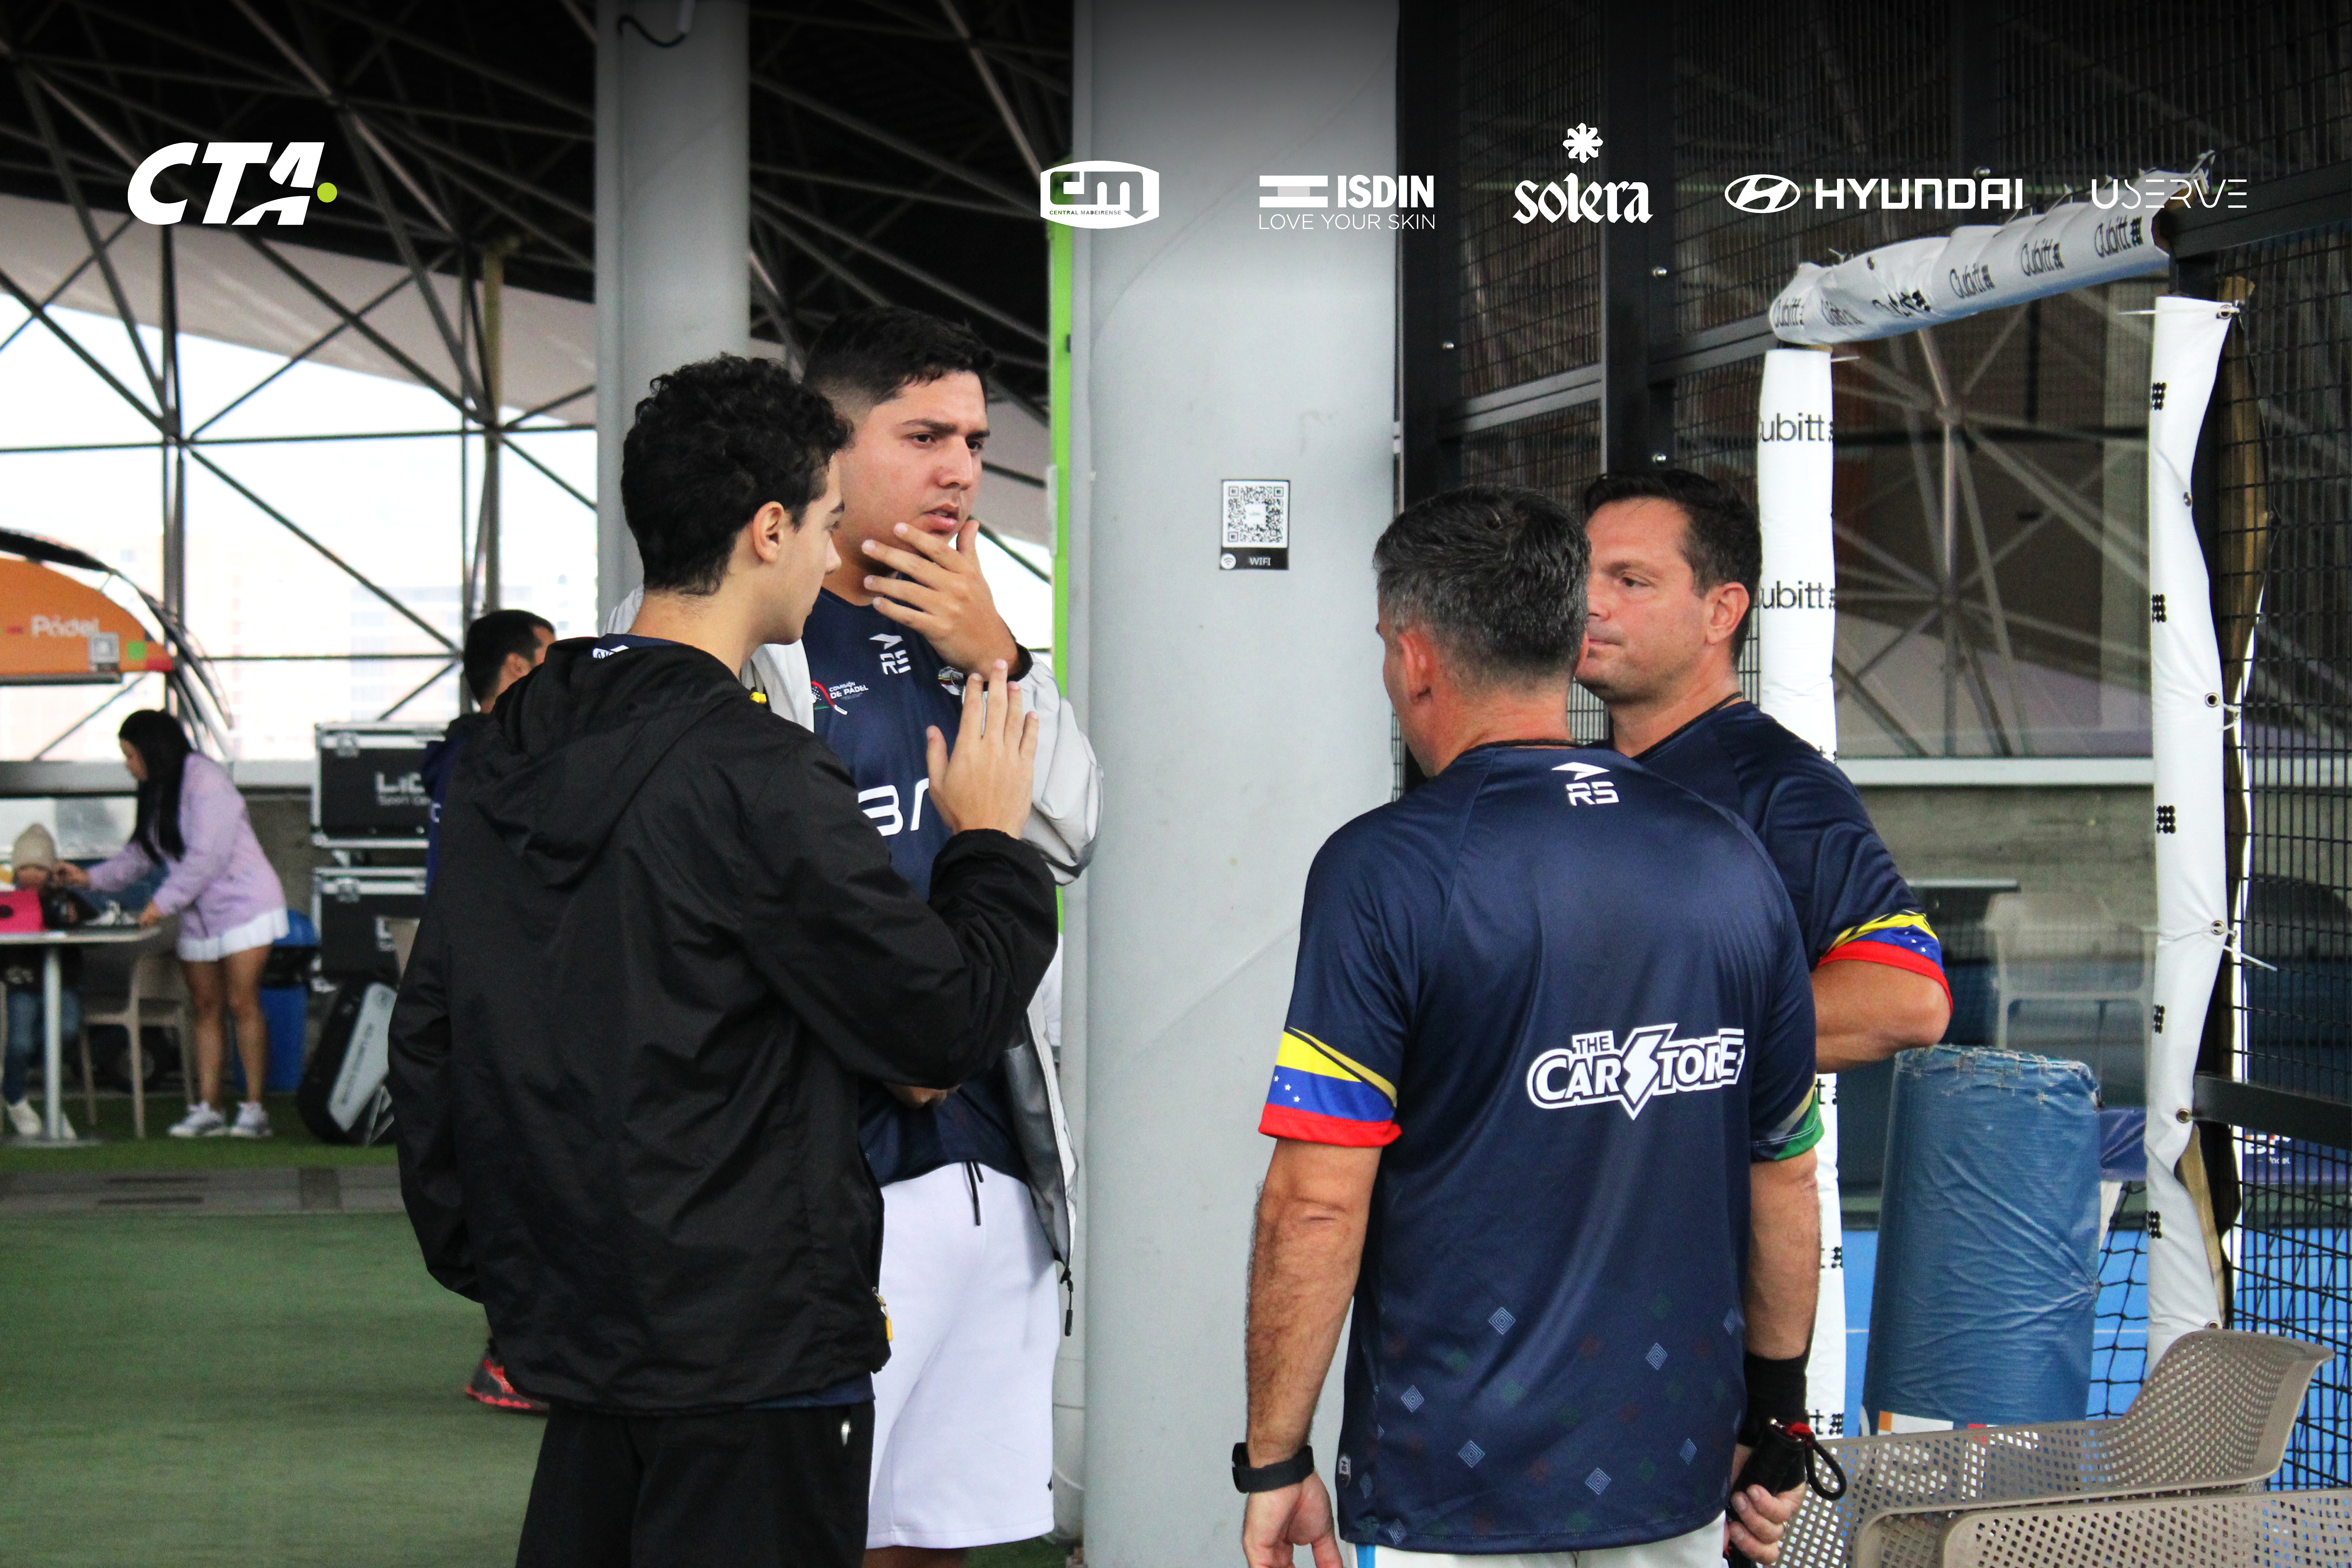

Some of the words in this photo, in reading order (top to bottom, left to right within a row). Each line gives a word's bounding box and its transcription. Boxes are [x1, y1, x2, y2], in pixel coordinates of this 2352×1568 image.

[2094, 215, 2131, 258] Cubitt
[2020, 238, 2054, 276] Cubitt
[1949, 263, 1986, 299] Cubitt
[1759, 412, 1825, 442] ubitt
[1249, 557, 1271, 566] WIFI
[1759, 580, 1825, 609] ubitt
[830, 691, 842, 699] DE
[1566, 781, 1620, 806] RS
[1576, 1035, 1610, 1054] THE
[1530, 1051, 1623, 1106] CAR
